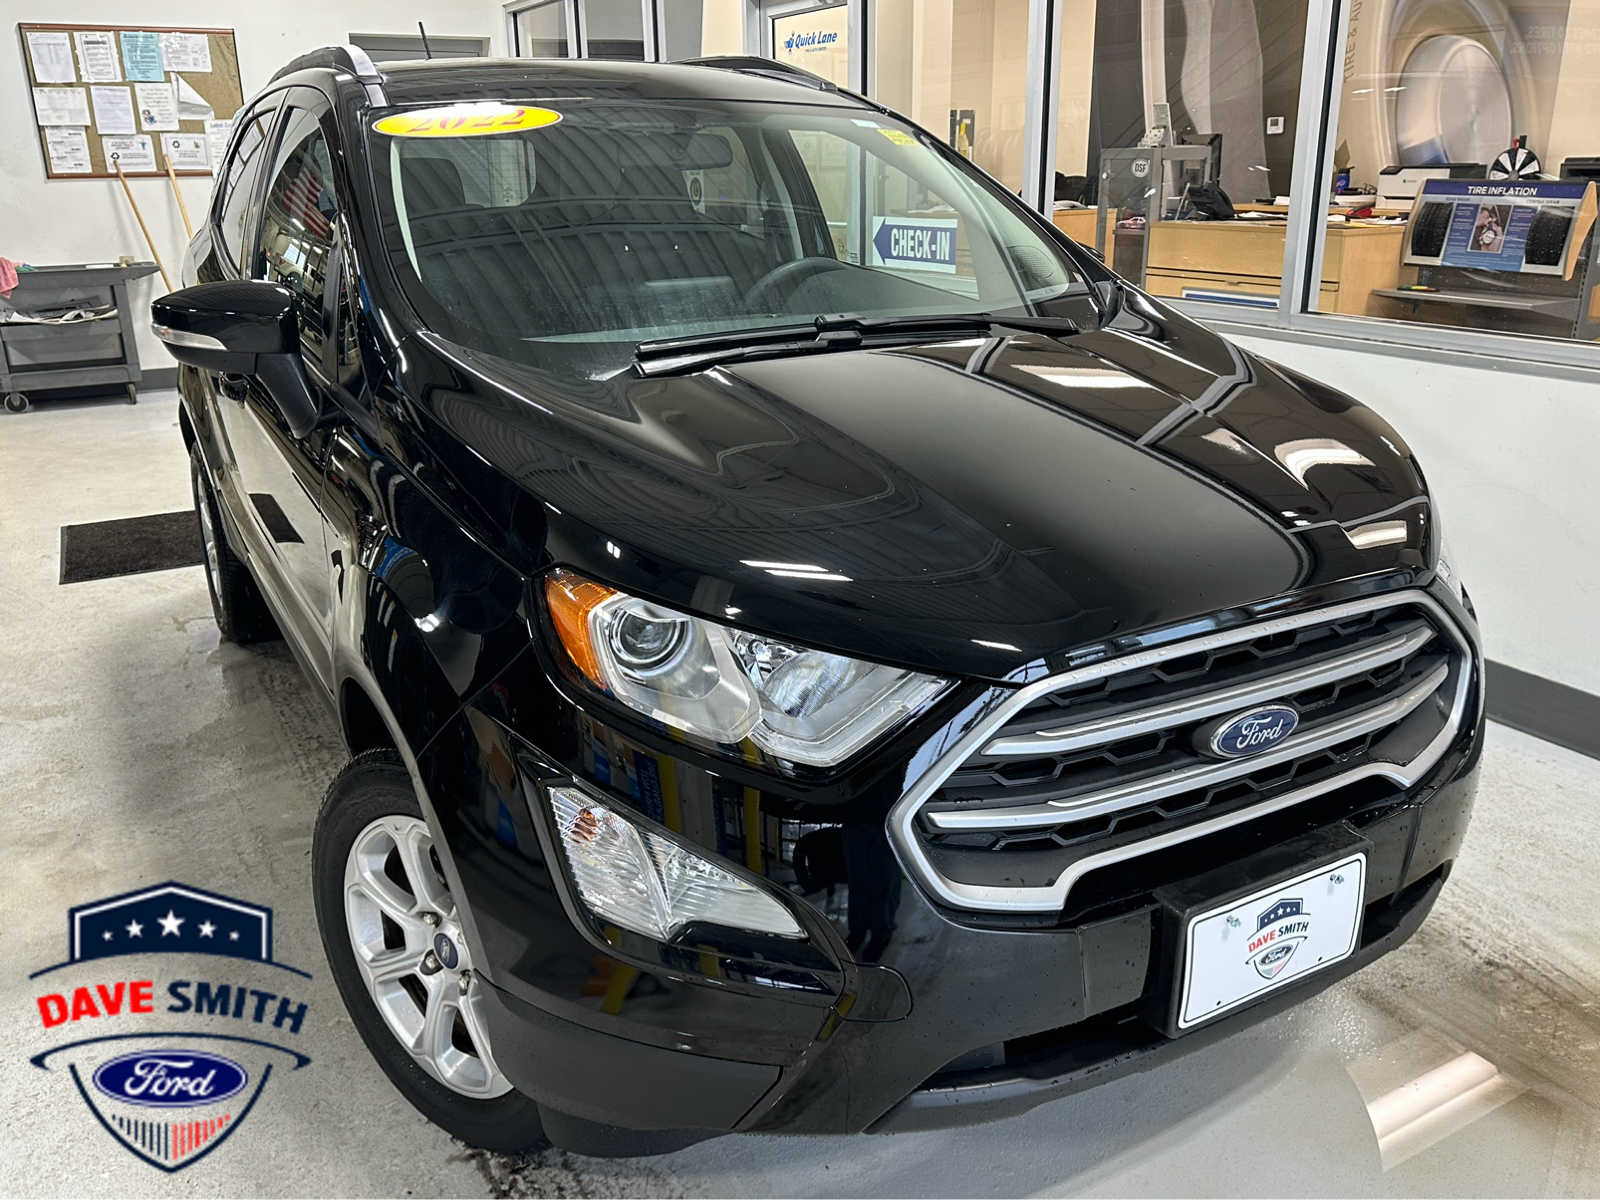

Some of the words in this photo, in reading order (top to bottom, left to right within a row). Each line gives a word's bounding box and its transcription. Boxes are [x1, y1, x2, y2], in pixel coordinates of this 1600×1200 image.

[795, 32, 817, 48] Quick
[817, 31, 838, 44] Lane
[1467, 186, 1488, 195] TIRE
[1488, 186, 1538, 196] INFLATION
[890, 228, 951, 260] CHECK-IN
[1236, 716, 1284, 749] Ford
[1248, 929, 1276, 953] DAVE
[1278, 921, 1309, 937] SMITH
